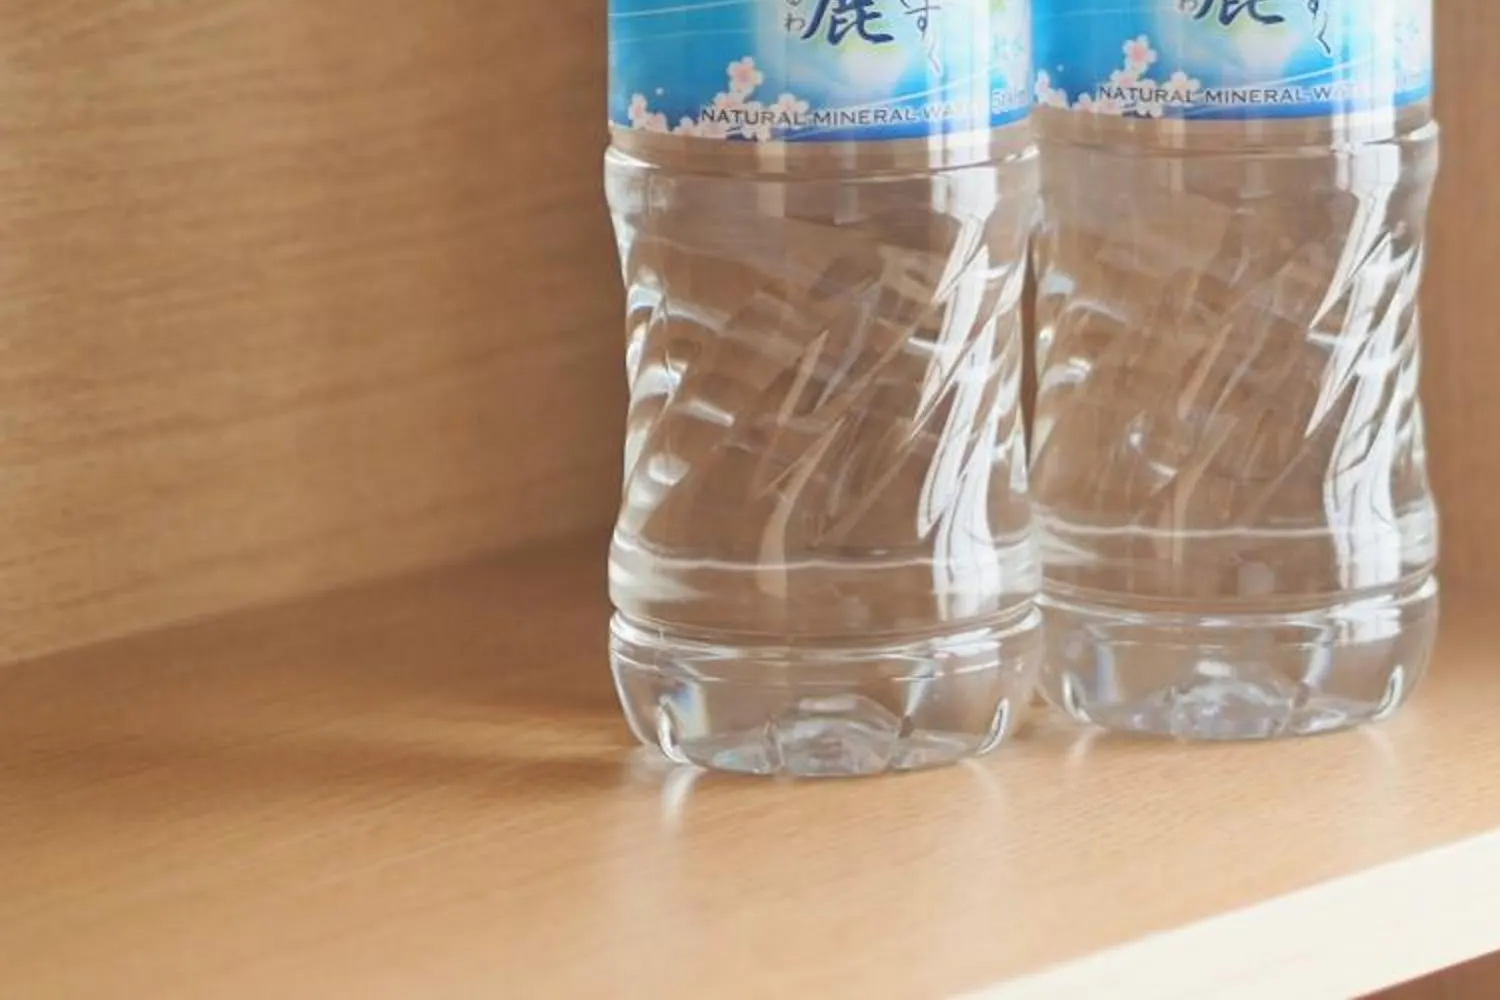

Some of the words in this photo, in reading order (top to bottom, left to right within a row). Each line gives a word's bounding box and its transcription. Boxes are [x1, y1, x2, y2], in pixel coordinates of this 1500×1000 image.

[1099, 86, 1197, 104] NATURAL
[1205, 87, 1303, 103] MINERAL
[701, 108, 806, 126] NATURAL
[813, 107, 917, 126] MINERAL
